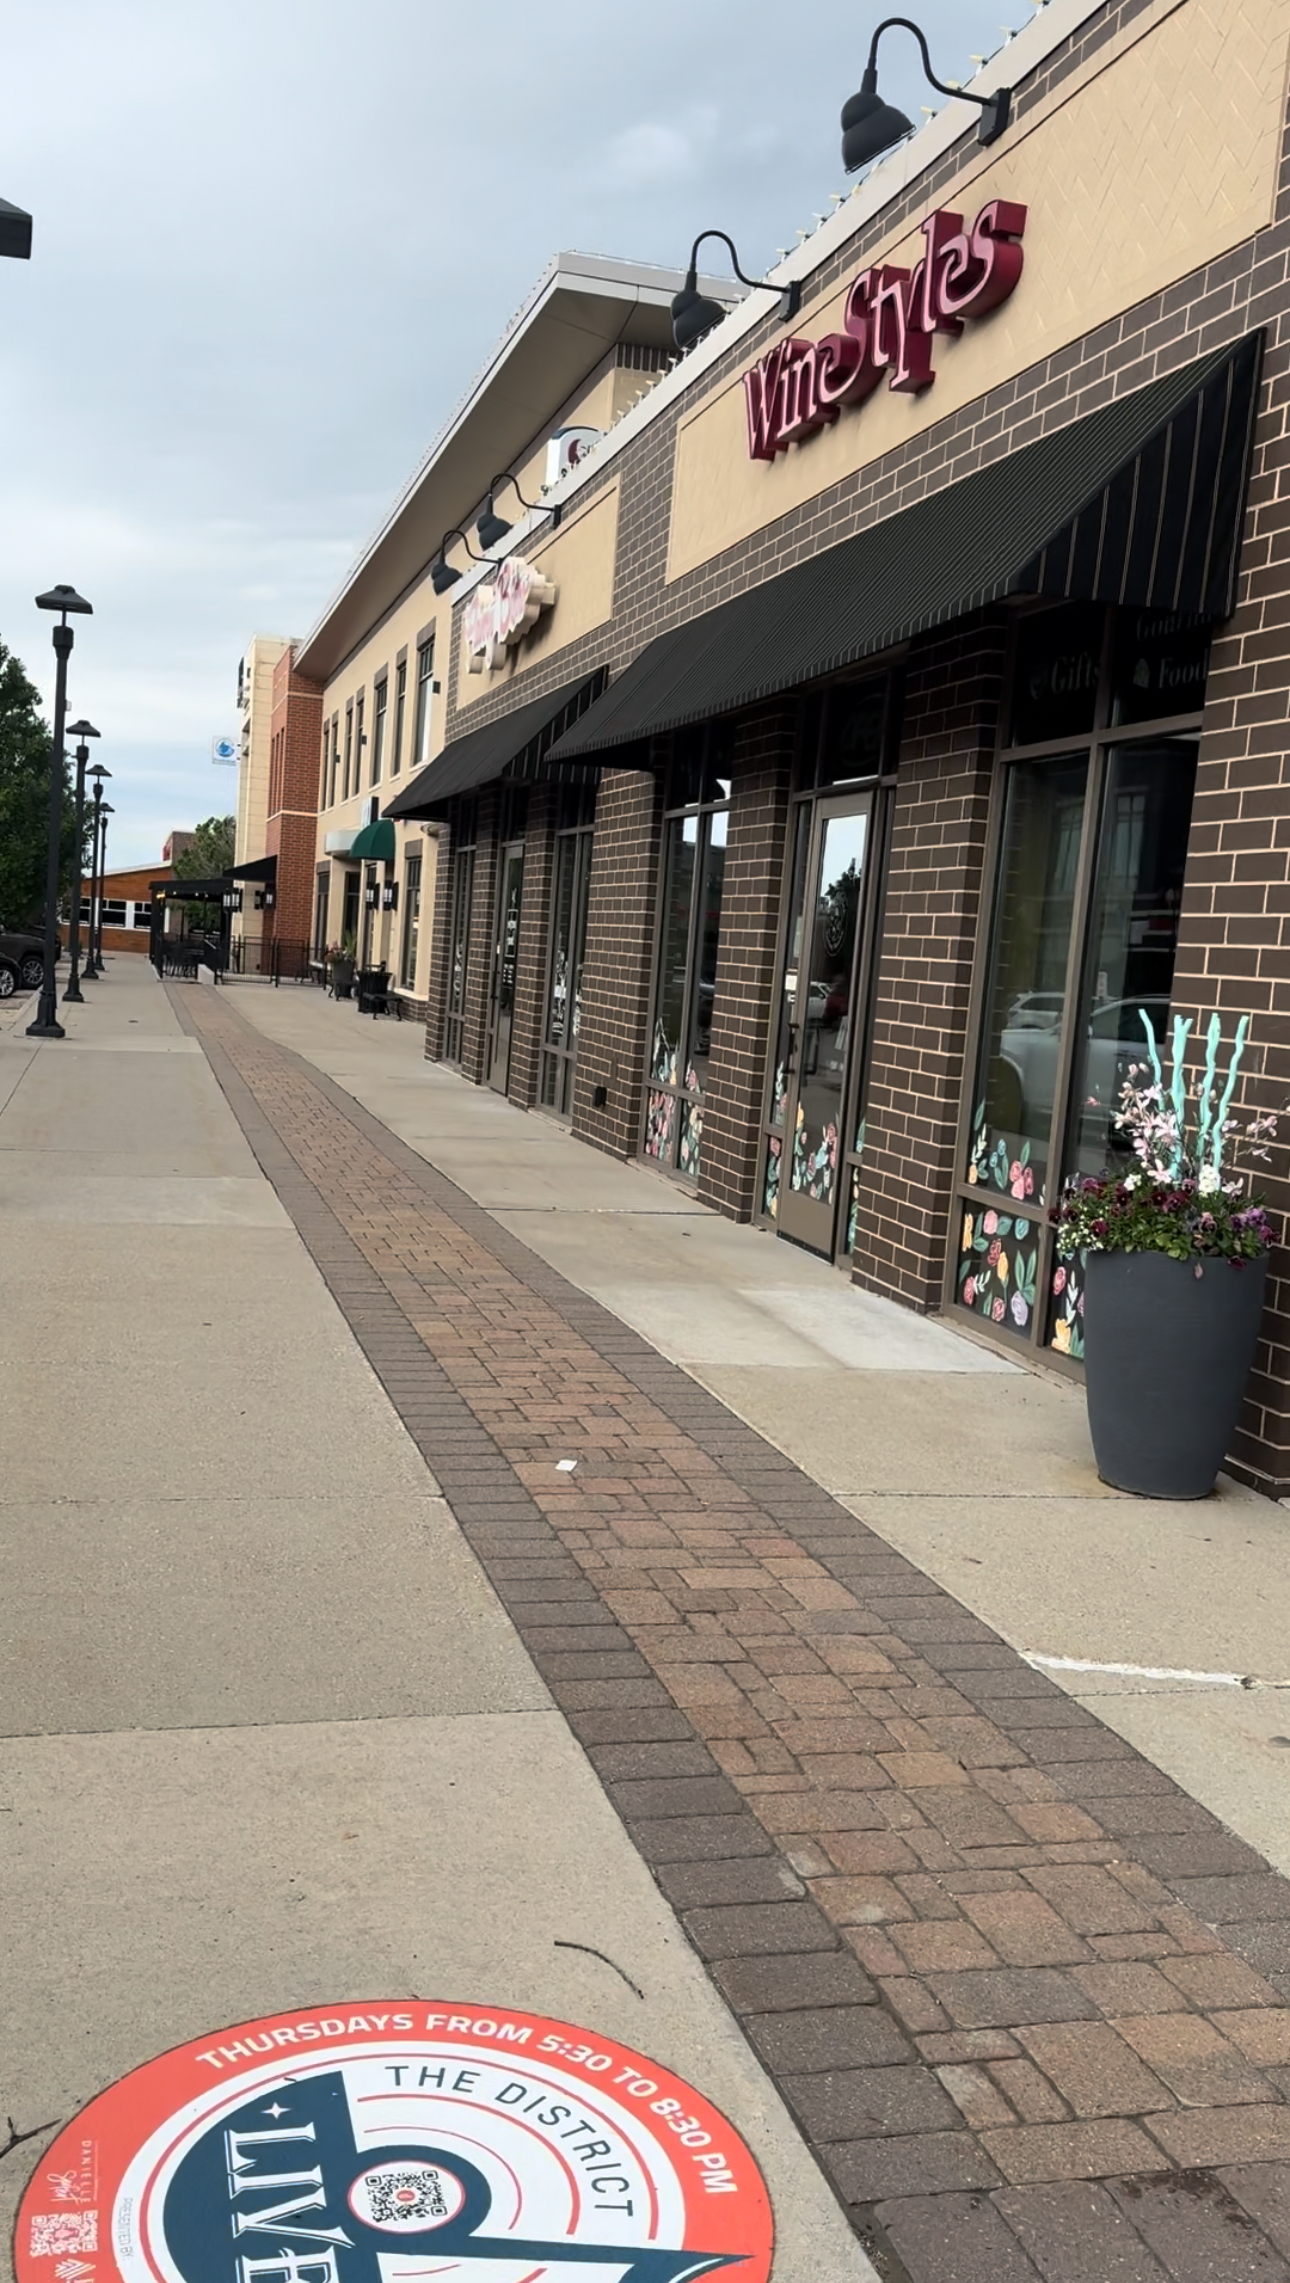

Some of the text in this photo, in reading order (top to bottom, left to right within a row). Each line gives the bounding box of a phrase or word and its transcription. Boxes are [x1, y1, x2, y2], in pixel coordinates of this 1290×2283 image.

[742, 199, 1028, 461] WineStyles
[80, 2140, 92, 2203] DANIELLE
[195, 2013, 738, 2195] THURSDAYS FROM 5:30 TO 8:30 PM
[384, 2065, 634, 2218] THE DISTRICT
